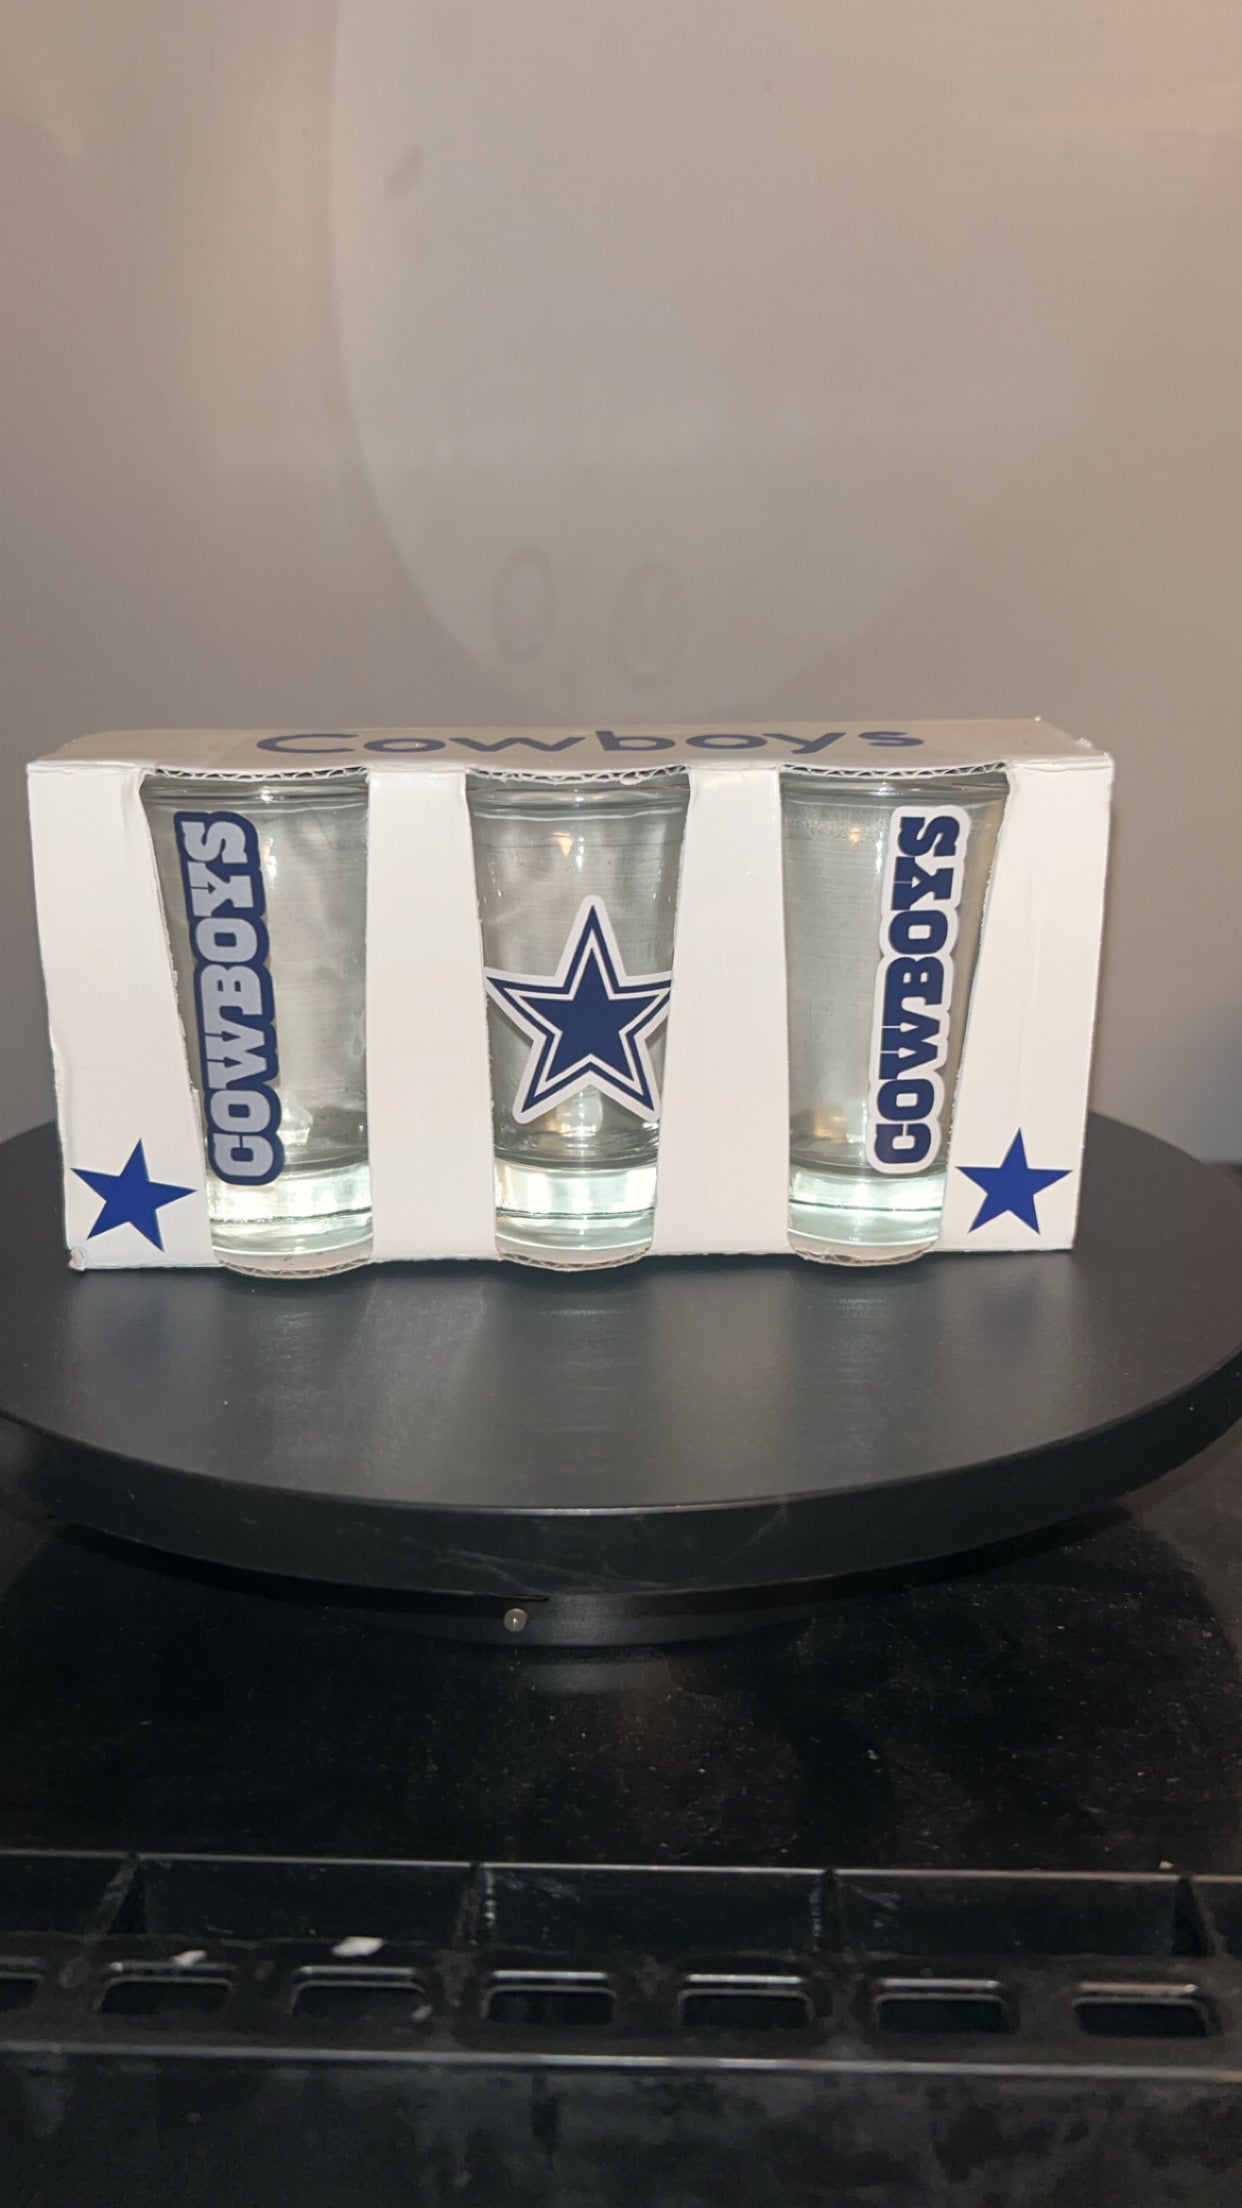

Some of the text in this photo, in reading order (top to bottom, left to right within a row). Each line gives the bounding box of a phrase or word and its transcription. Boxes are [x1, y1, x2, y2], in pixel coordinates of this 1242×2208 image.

[256, 729, 925, 755] Cowboys
[180, 820, 274, 1178] COWBOYS
[874, 814, 961, 1165] COWBOYS
